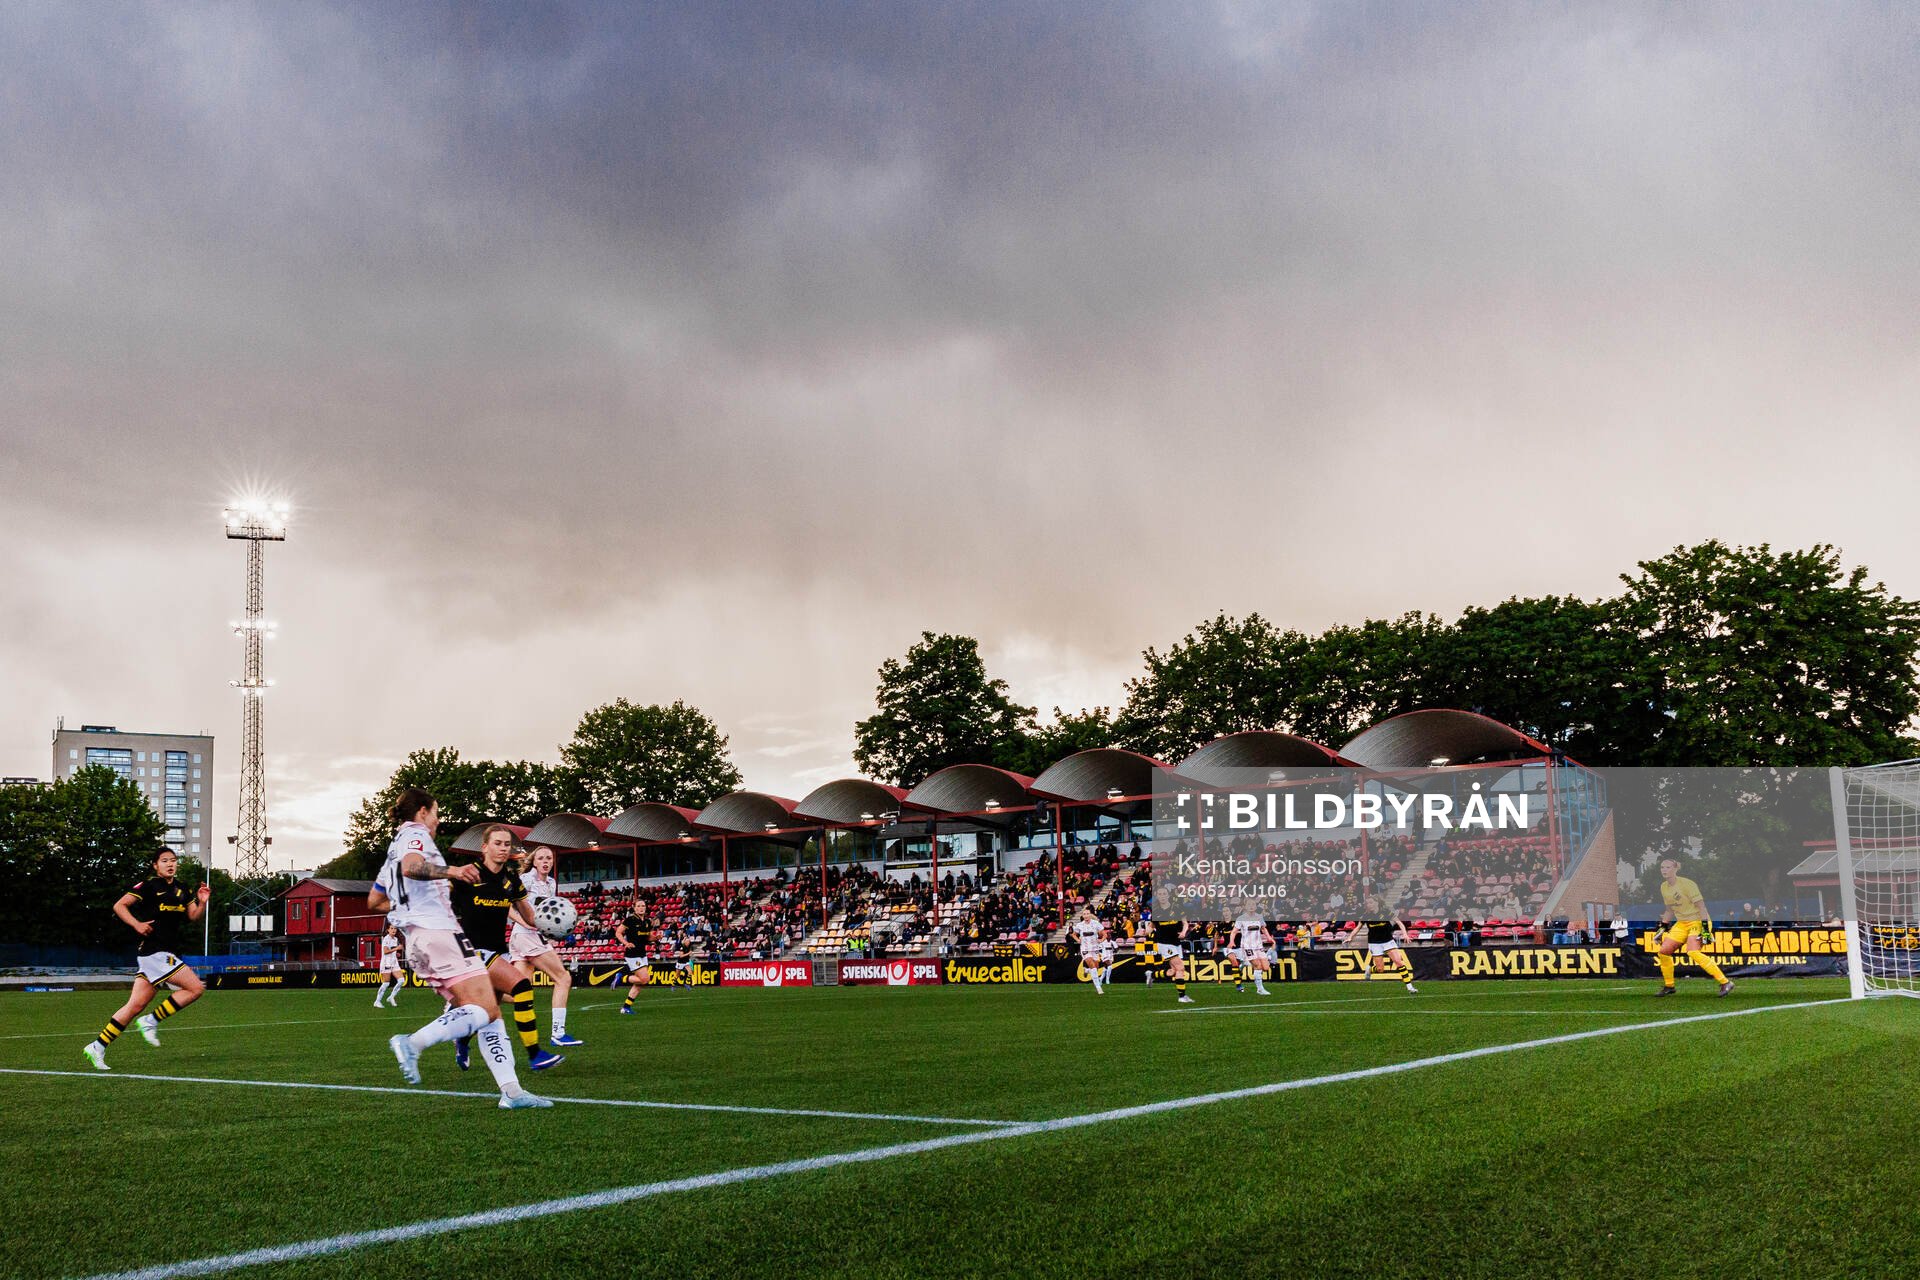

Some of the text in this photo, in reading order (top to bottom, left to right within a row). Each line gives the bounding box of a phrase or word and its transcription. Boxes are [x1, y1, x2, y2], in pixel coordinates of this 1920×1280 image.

[945, 958, 1047, 983] truecaller
[1450, 948, 1622, 976] RAMIRENT
[341, 972, 384, 984] BRANDTOW
[647, 964, 718, 985] truecller
[724, 967, 807, 981] SVENSKA SPEL
[842, 965, 938, 979] SVENSKA SPEL
